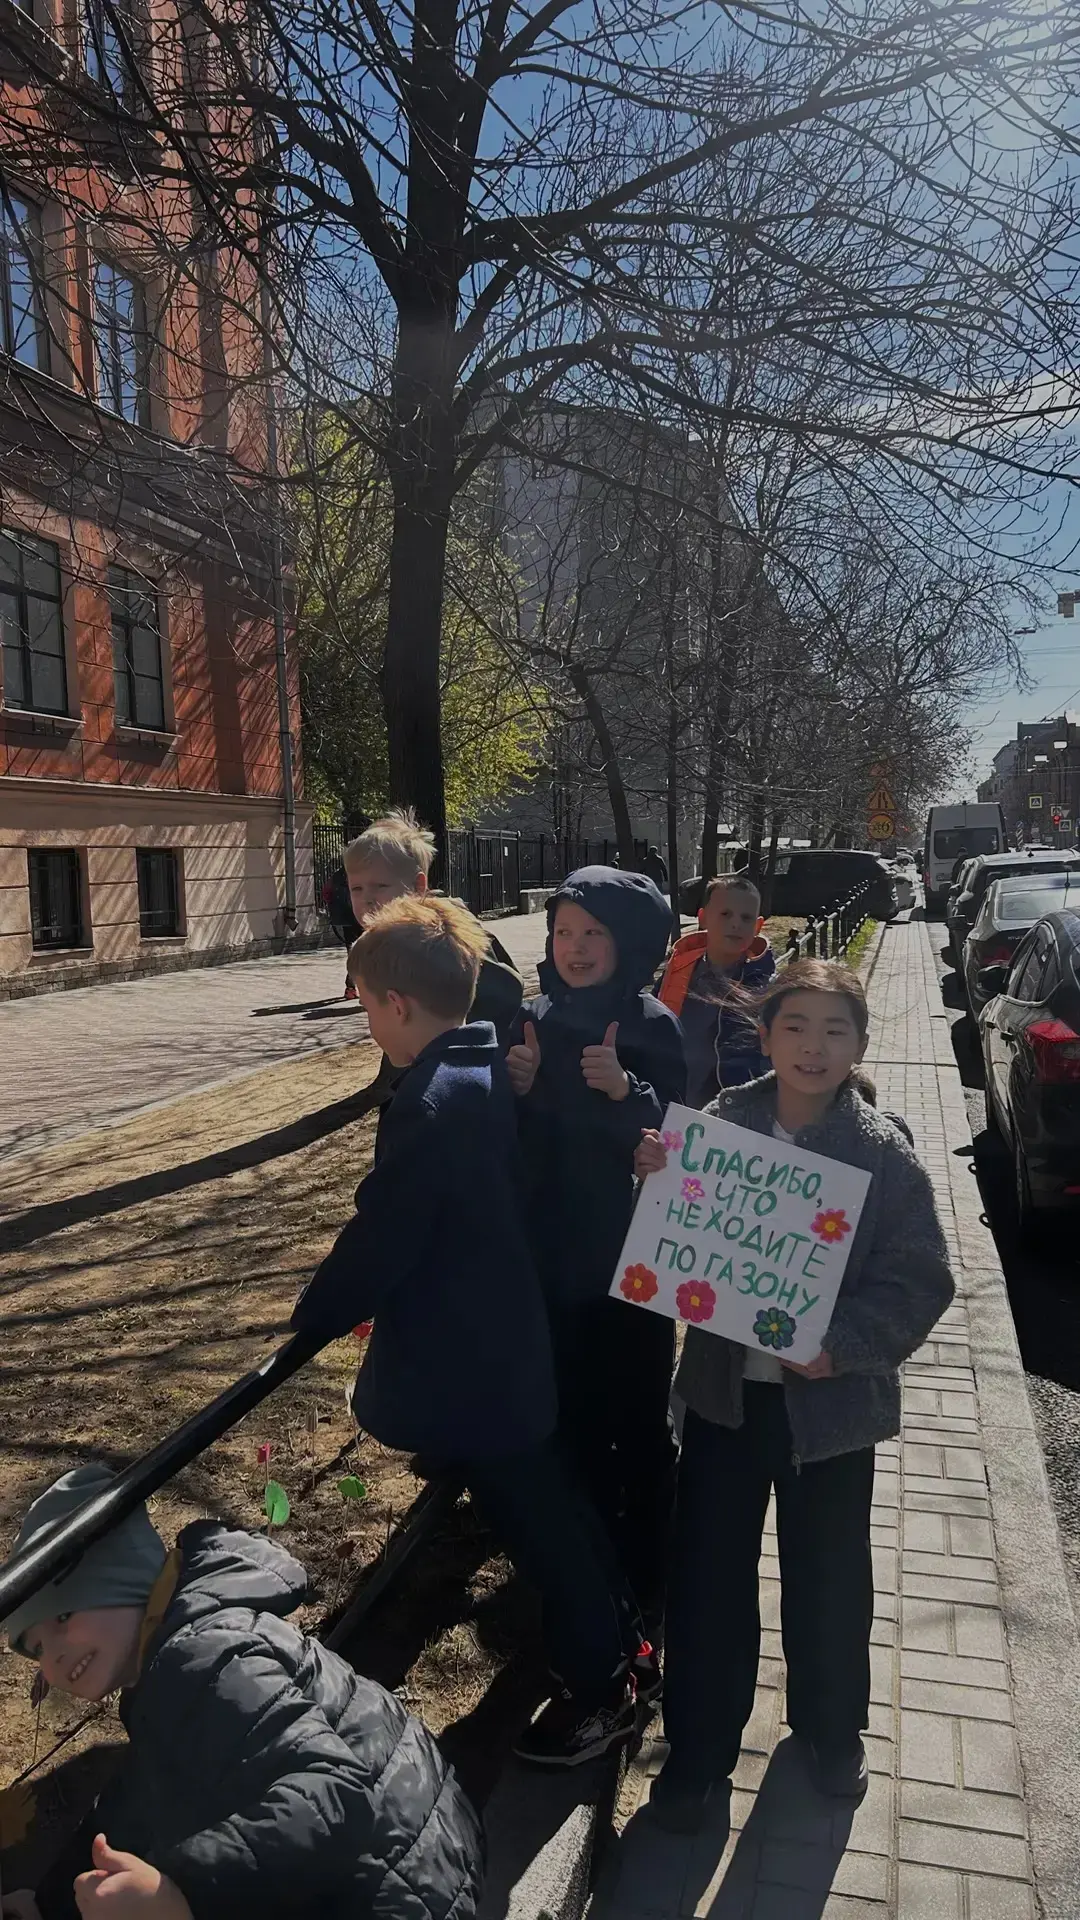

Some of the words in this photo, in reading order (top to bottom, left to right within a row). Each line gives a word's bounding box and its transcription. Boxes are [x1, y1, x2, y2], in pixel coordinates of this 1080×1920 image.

[714, 1181, 778, 1217] ЧТО
[653, 1236, 697, 1274] ПО
[703, 1252, 821, 1317] ГАЗОНУ
